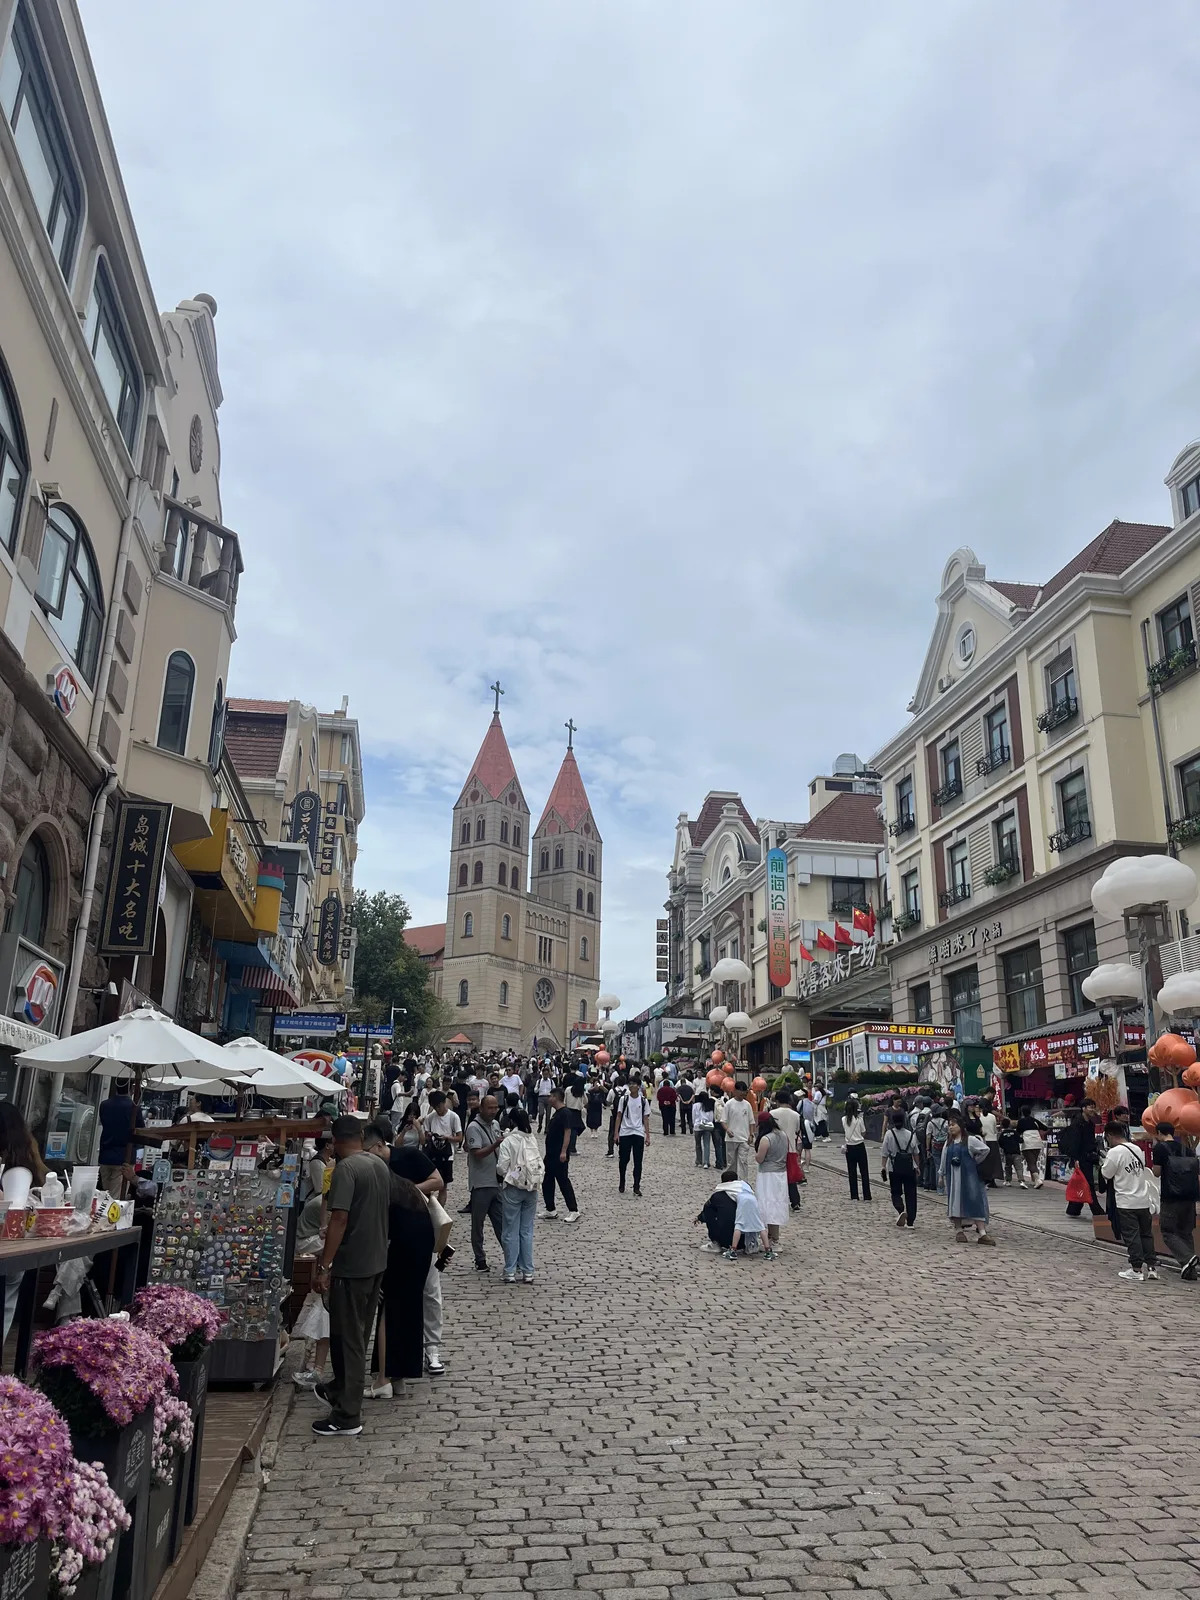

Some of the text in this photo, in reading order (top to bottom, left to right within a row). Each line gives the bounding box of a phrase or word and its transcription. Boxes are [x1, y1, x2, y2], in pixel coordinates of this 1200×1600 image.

[118, 814, 149, 940] 岛城十大名吃
[770, 856, 785, 911] 前海沿
[889, 1025, 935, 1035] 幸运便利店
